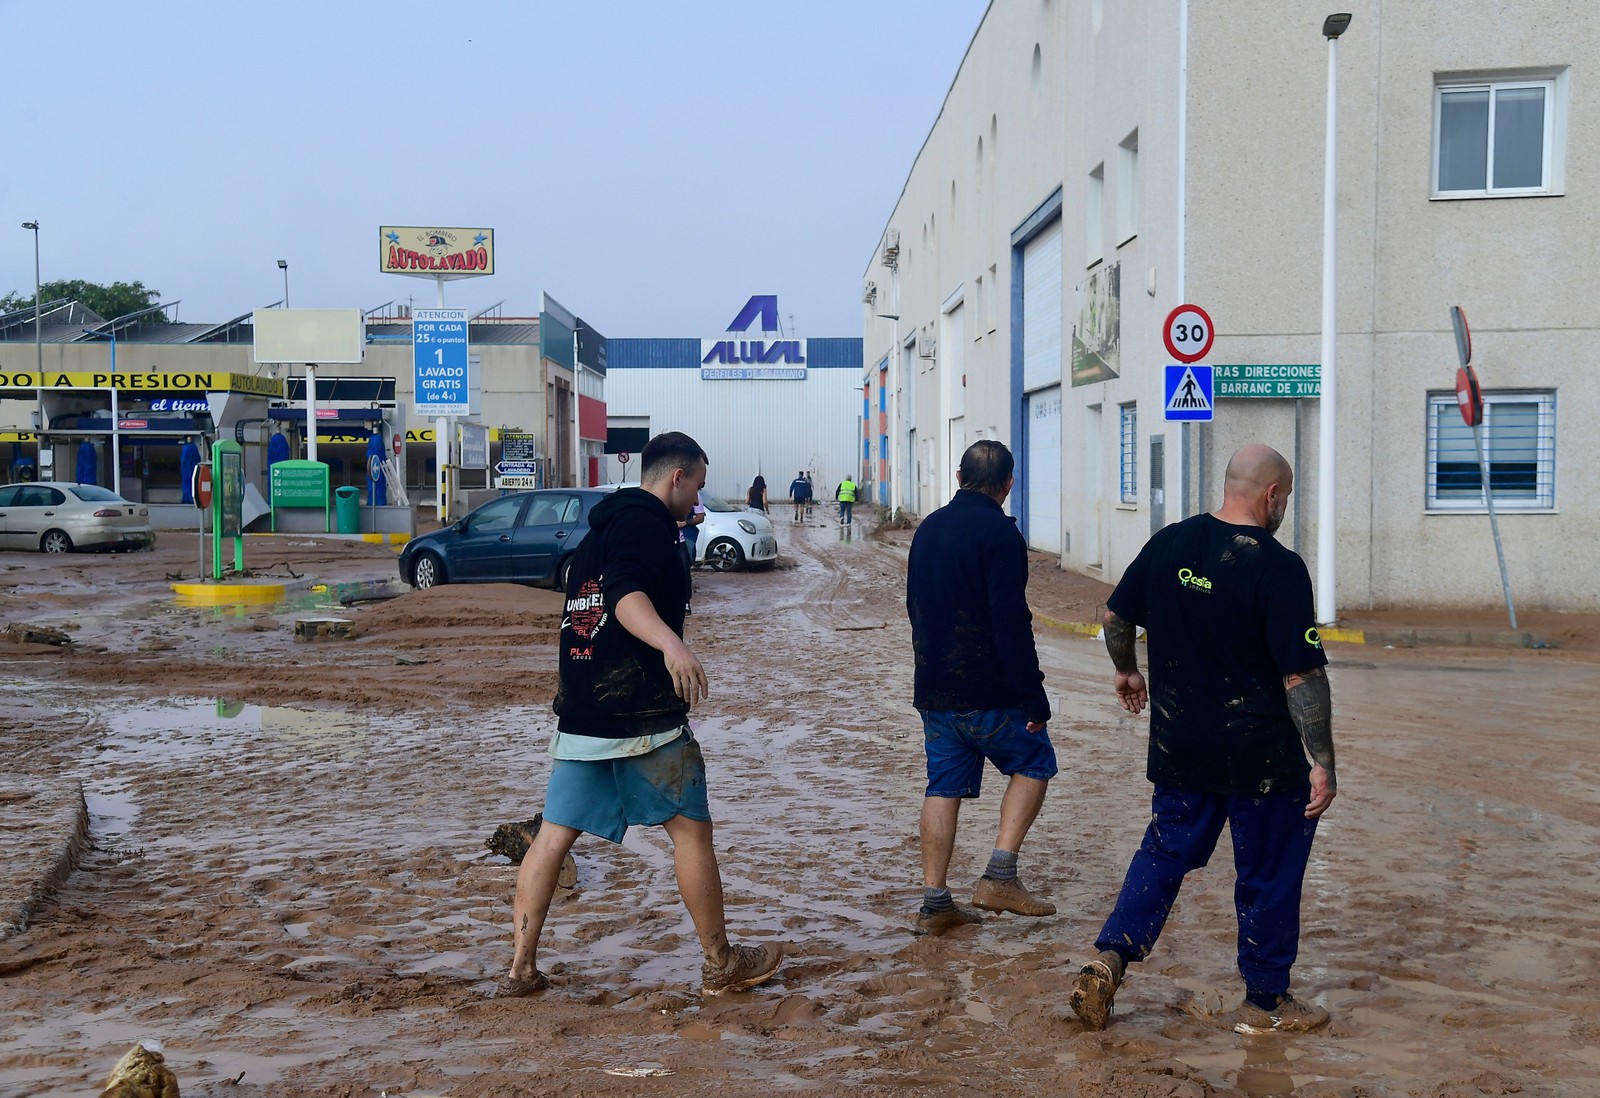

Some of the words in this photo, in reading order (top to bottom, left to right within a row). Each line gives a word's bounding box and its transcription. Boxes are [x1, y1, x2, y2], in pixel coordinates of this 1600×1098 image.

[426, 230, 457, 242] BOMBERO
[387, 245, 488, 270] AUTOLAVADO
[417, 311, 464, 319] ATENCION
[439, 324, 463, 332] CADA
[1176, 324, 1204, 342] 30
[416, 333, 430, 343] 25
[434, 348, 443, 365] 1
[702, 341, 805, 364] ALUVAL
[419, 367, 464, 377] LAVADO
[703, 369, 743, 379] PERFILES
[1245, 366, 1321, 377] DIRECCIONES
[54, 374, 73, 388] A
[93, 373, 212, 389] PRESION
[231, 374, 278, 394] AUTOLAVADO
[422, 379, 461, 389] GRATIS
[1221, 382, 1272, 394] BARRANC
[1277, 383, 1291, 394] DE
[1296, 382, 1321, 394] XIVA
[151, 399, 167, 411] el
[502, 478, 520, 486] ABIERTO
[521, 477, 529, 487] 24
